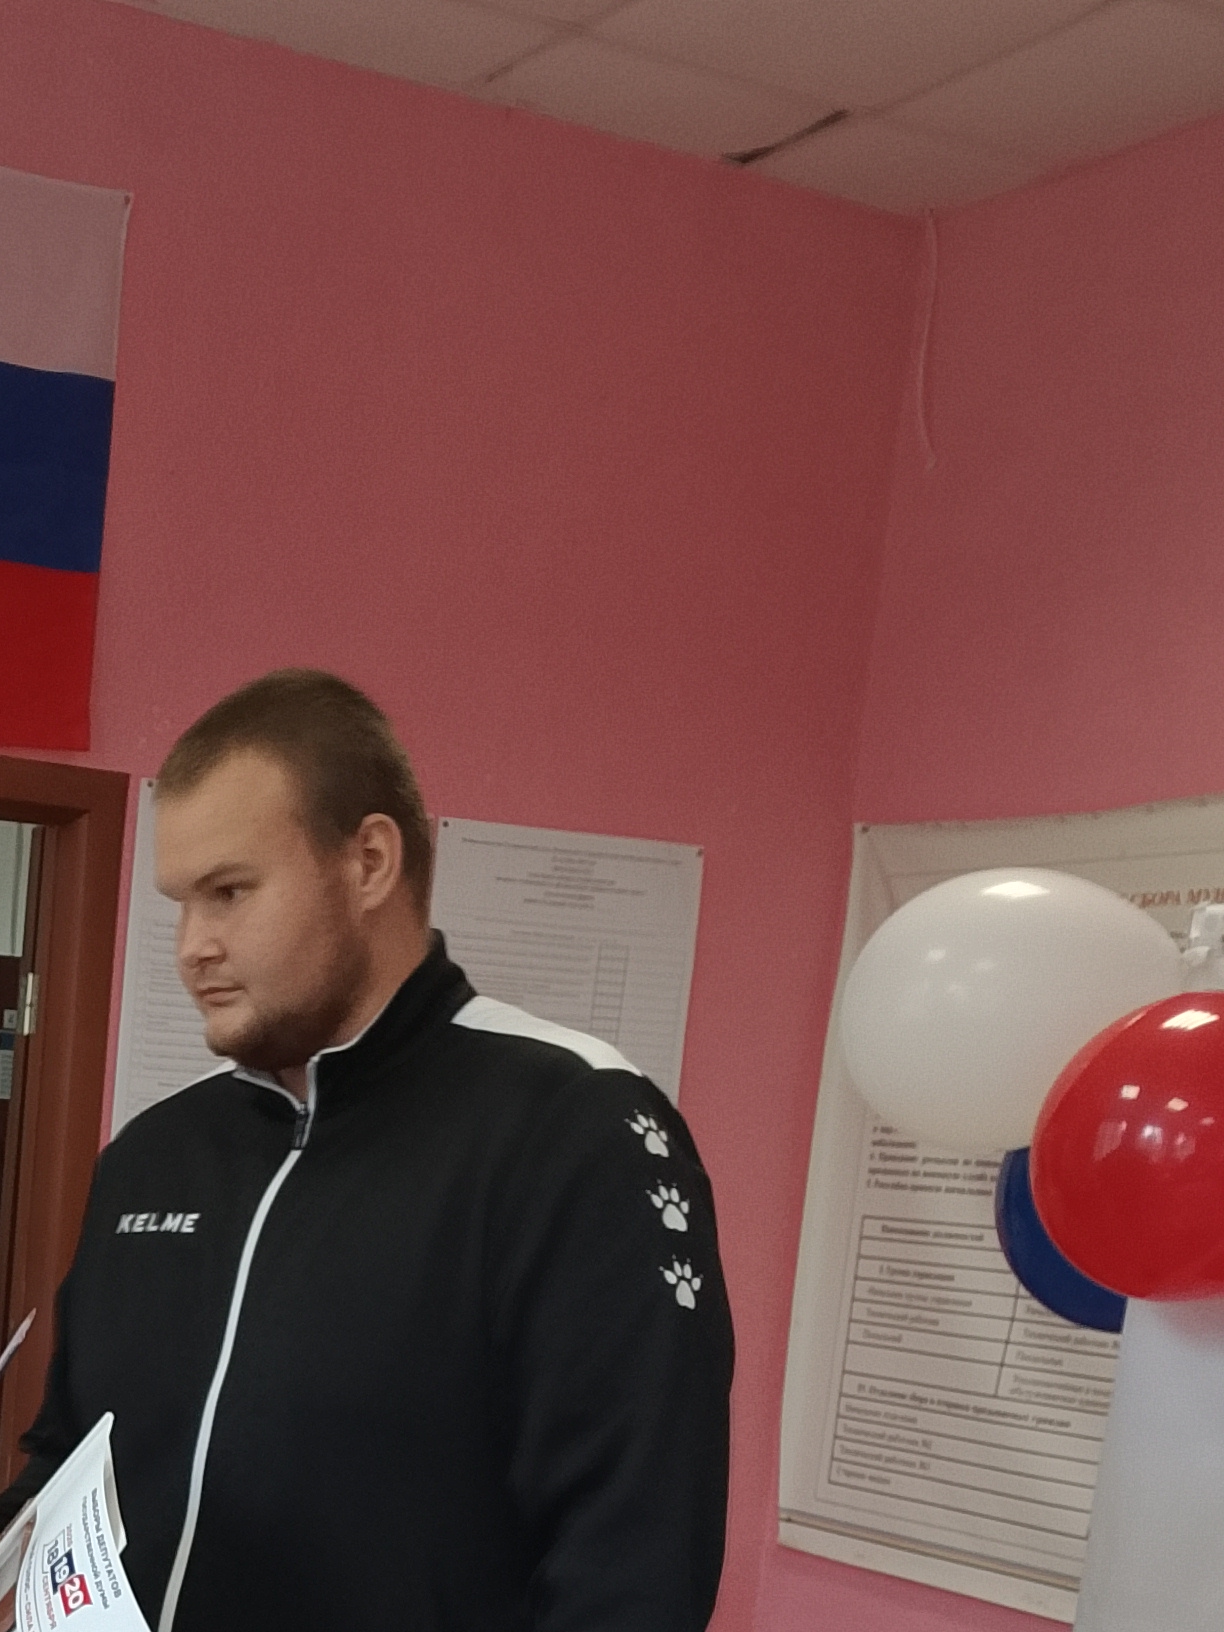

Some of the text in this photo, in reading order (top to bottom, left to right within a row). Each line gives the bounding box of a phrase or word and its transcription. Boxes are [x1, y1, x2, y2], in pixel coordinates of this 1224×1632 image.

[115, 1212, 201, 1234] KELME
[47, 1540, 84, 1609] 18 19 20
[96, 1534, 122, 1599] ДЕПУТАТОВ
[42, 1575, 57, 1630] СЕНТЯБРЯ
[95, 1580, 110, 1610] ДУМЫ
